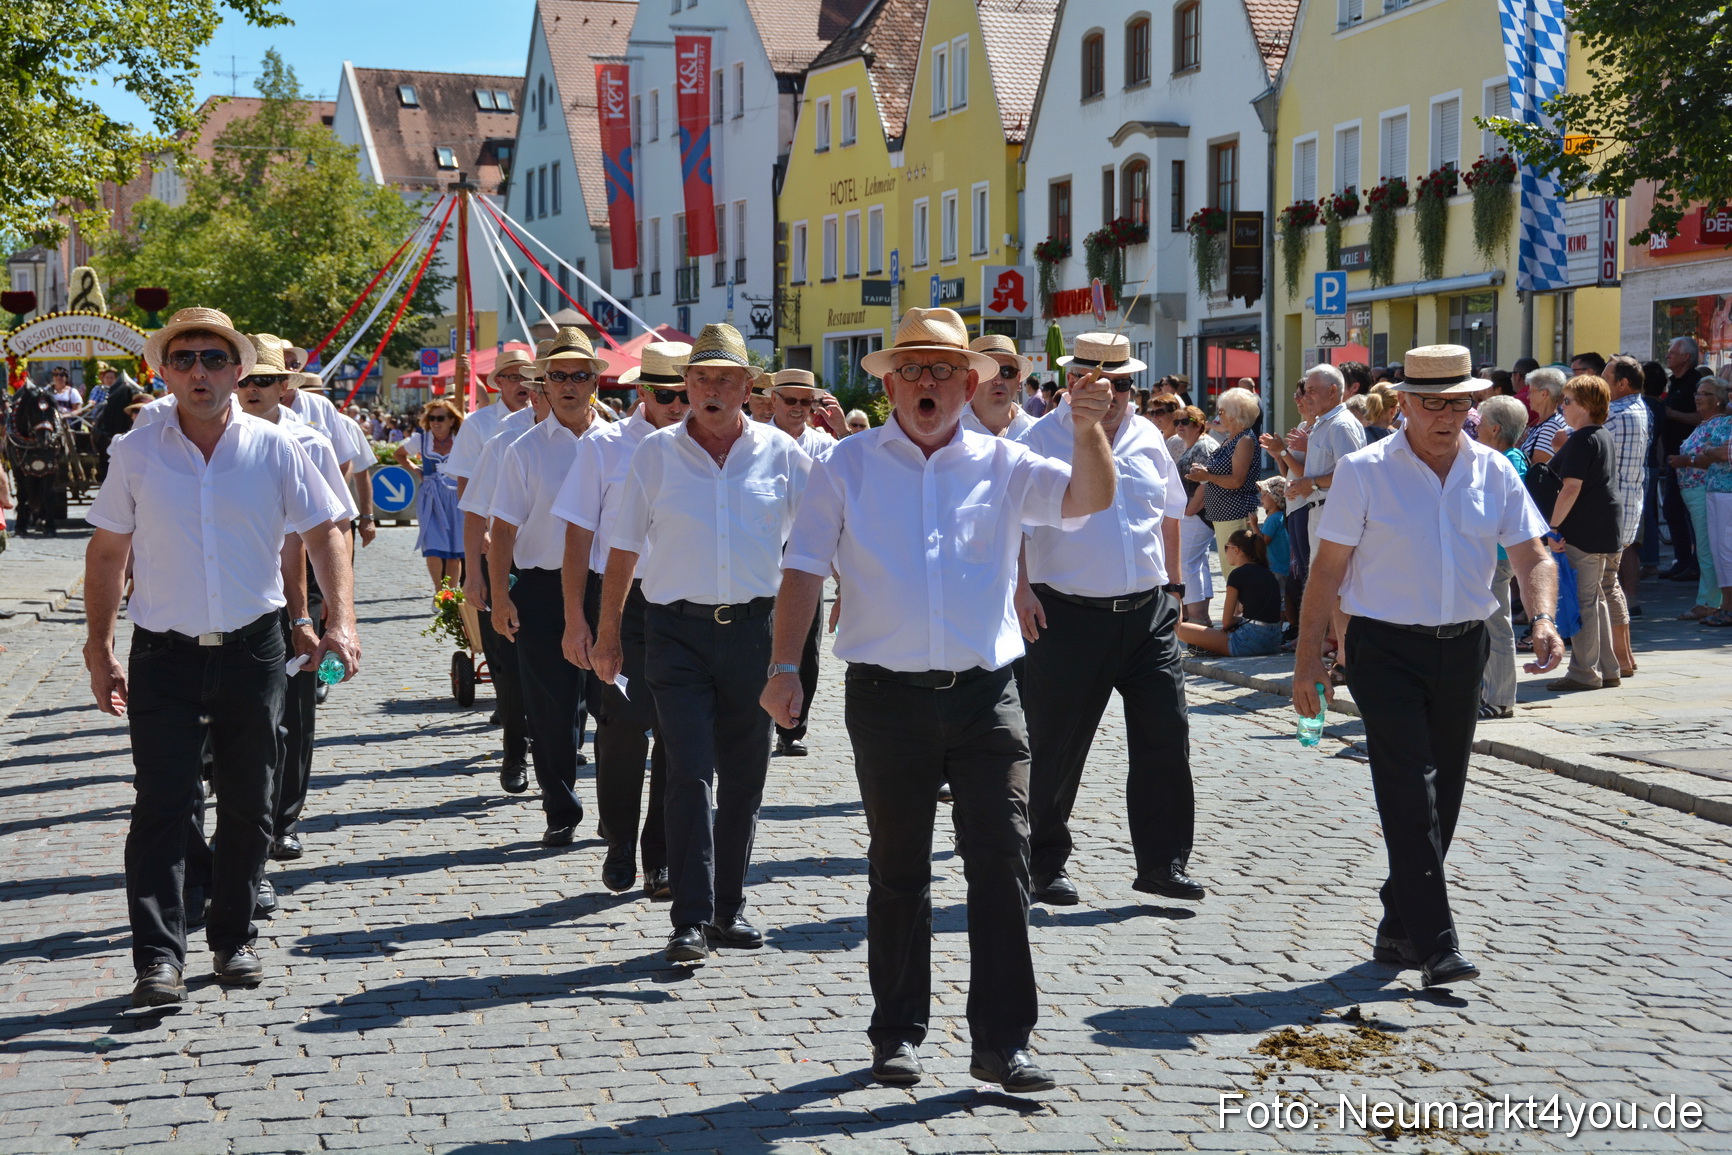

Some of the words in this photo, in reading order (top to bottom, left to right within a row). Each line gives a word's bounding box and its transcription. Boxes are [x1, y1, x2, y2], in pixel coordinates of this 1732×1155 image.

[680, 43, 698, 94] K&L
[830, 178, 858, 206] HOTEL
[864, 173, 896, 197] Lehmeier
[1567, 235, 1588, 253] KINO
[1604, 200, 1615, 279] KINO
[864, 295, 890, 303] TAIFU
[1322, 277, 1339, 310] P
[827, 309, 866, 327] Restaurant
[14, 319, 101, 351] Gesangverein
